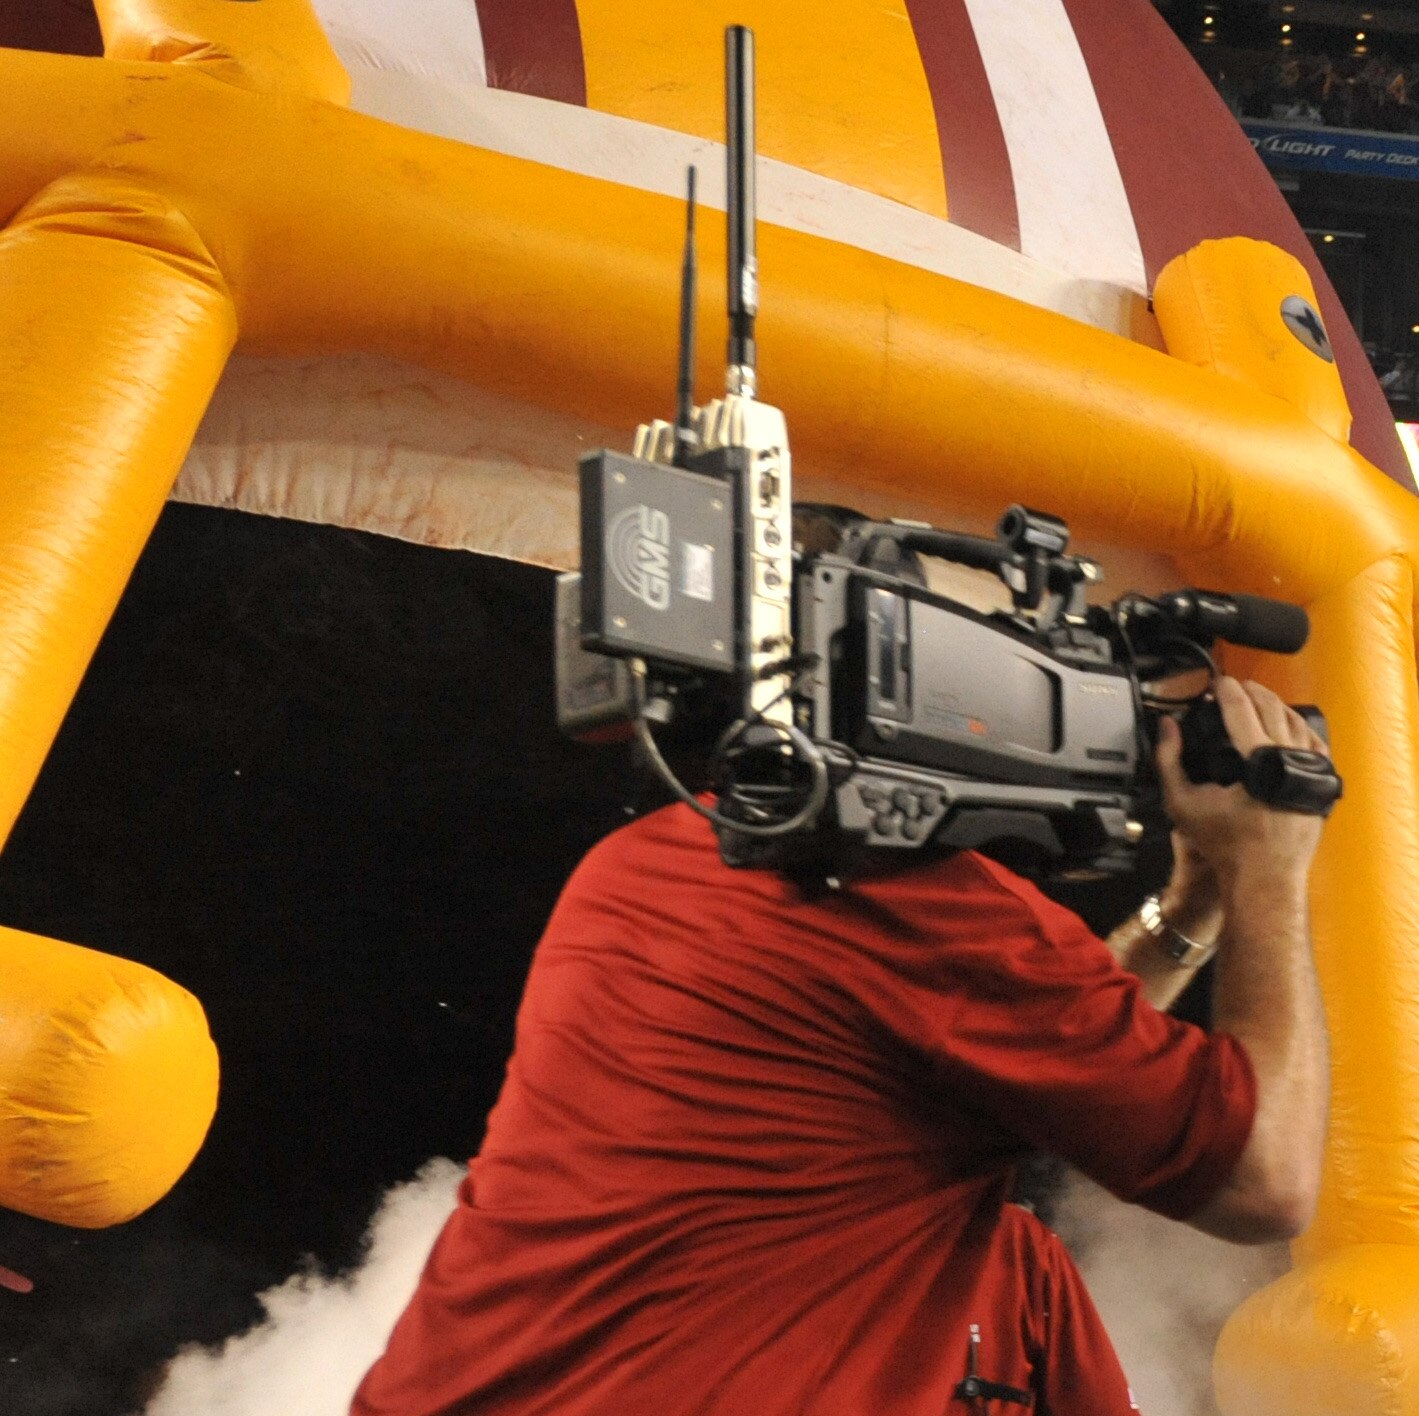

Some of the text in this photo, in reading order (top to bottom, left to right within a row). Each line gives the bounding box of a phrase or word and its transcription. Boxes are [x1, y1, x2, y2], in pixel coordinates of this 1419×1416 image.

[1269, 140, 1335, 158] LIGHT
[1345, 149, 1386, 163] PARTY
[1386, 153, 1419, 166] DECK
[640, 503, 671, 611] GMS
